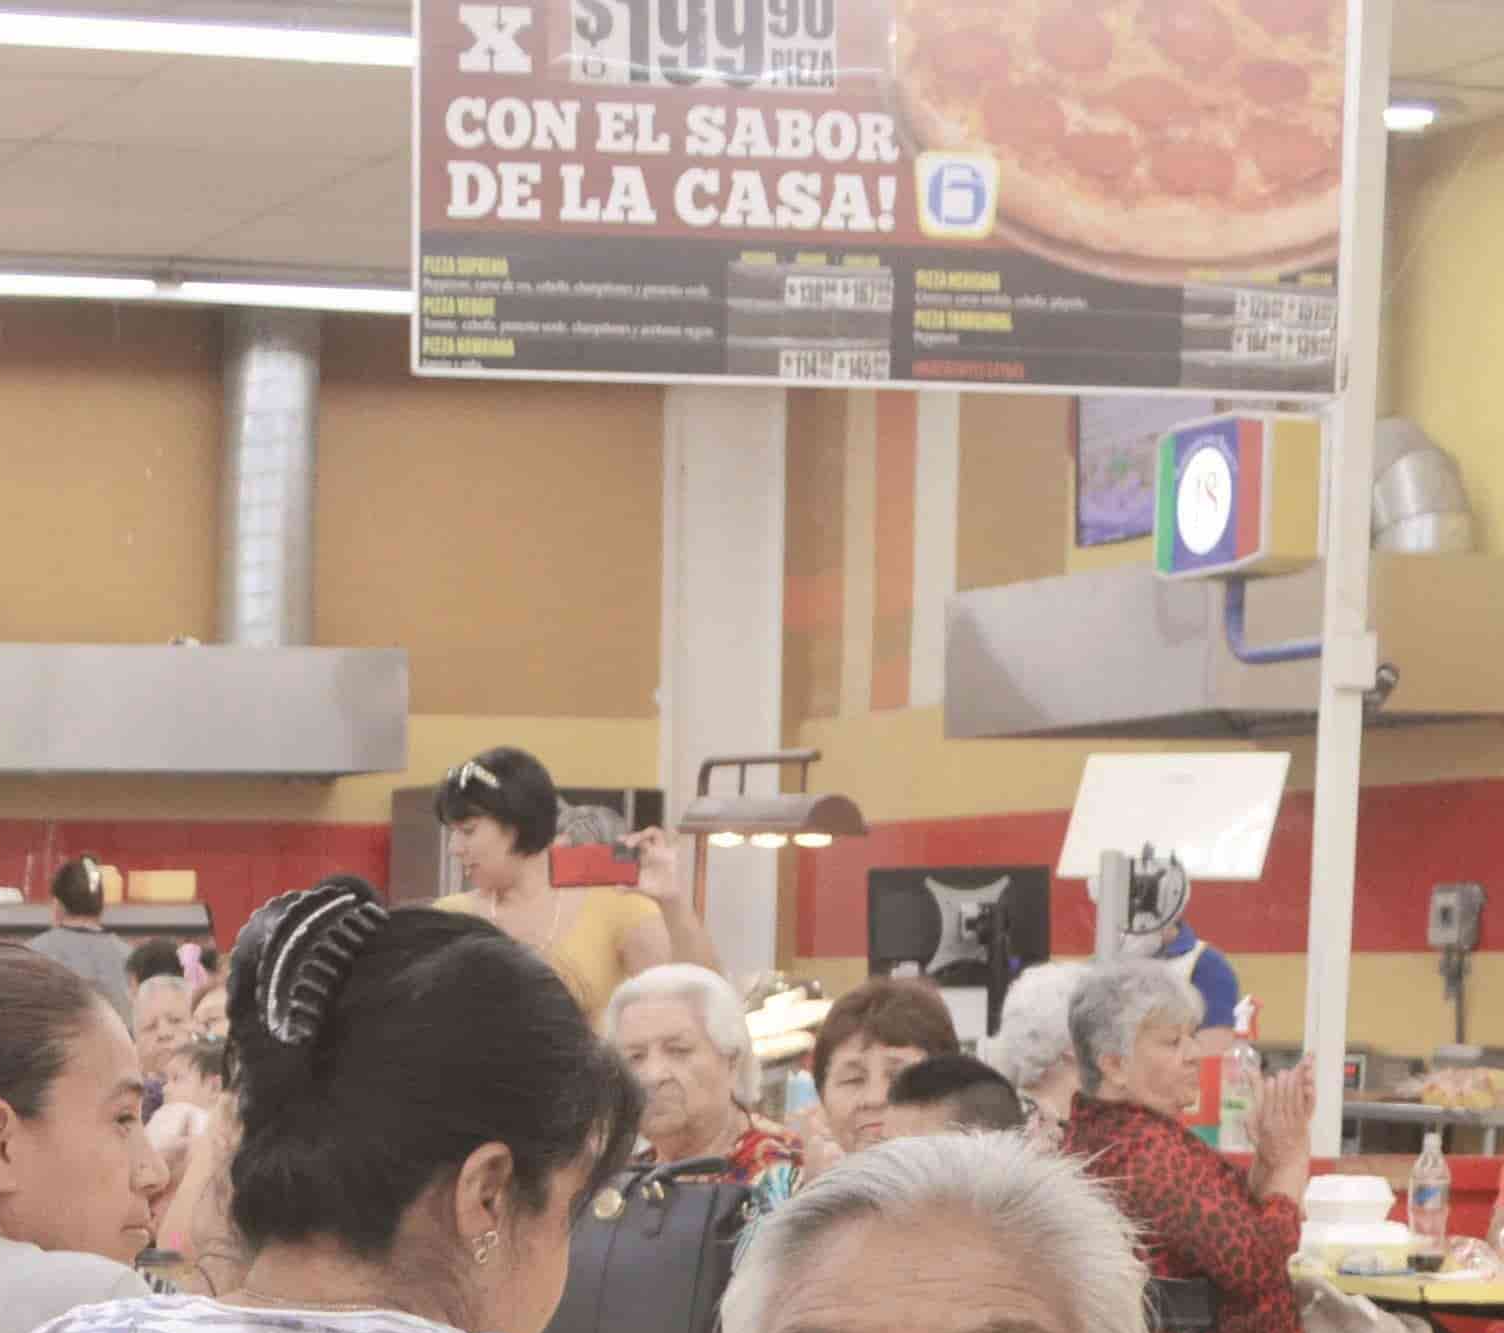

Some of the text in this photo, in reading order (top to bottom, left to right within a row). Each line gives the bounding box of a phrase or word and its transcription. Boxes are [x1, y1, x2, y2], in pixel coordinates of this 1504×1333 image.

[770, 47, 835, 89] PIEZA
[445, 97, 900, 163] CON EL SABOR
[446, 160, 897, 232] DE LA CASA!
